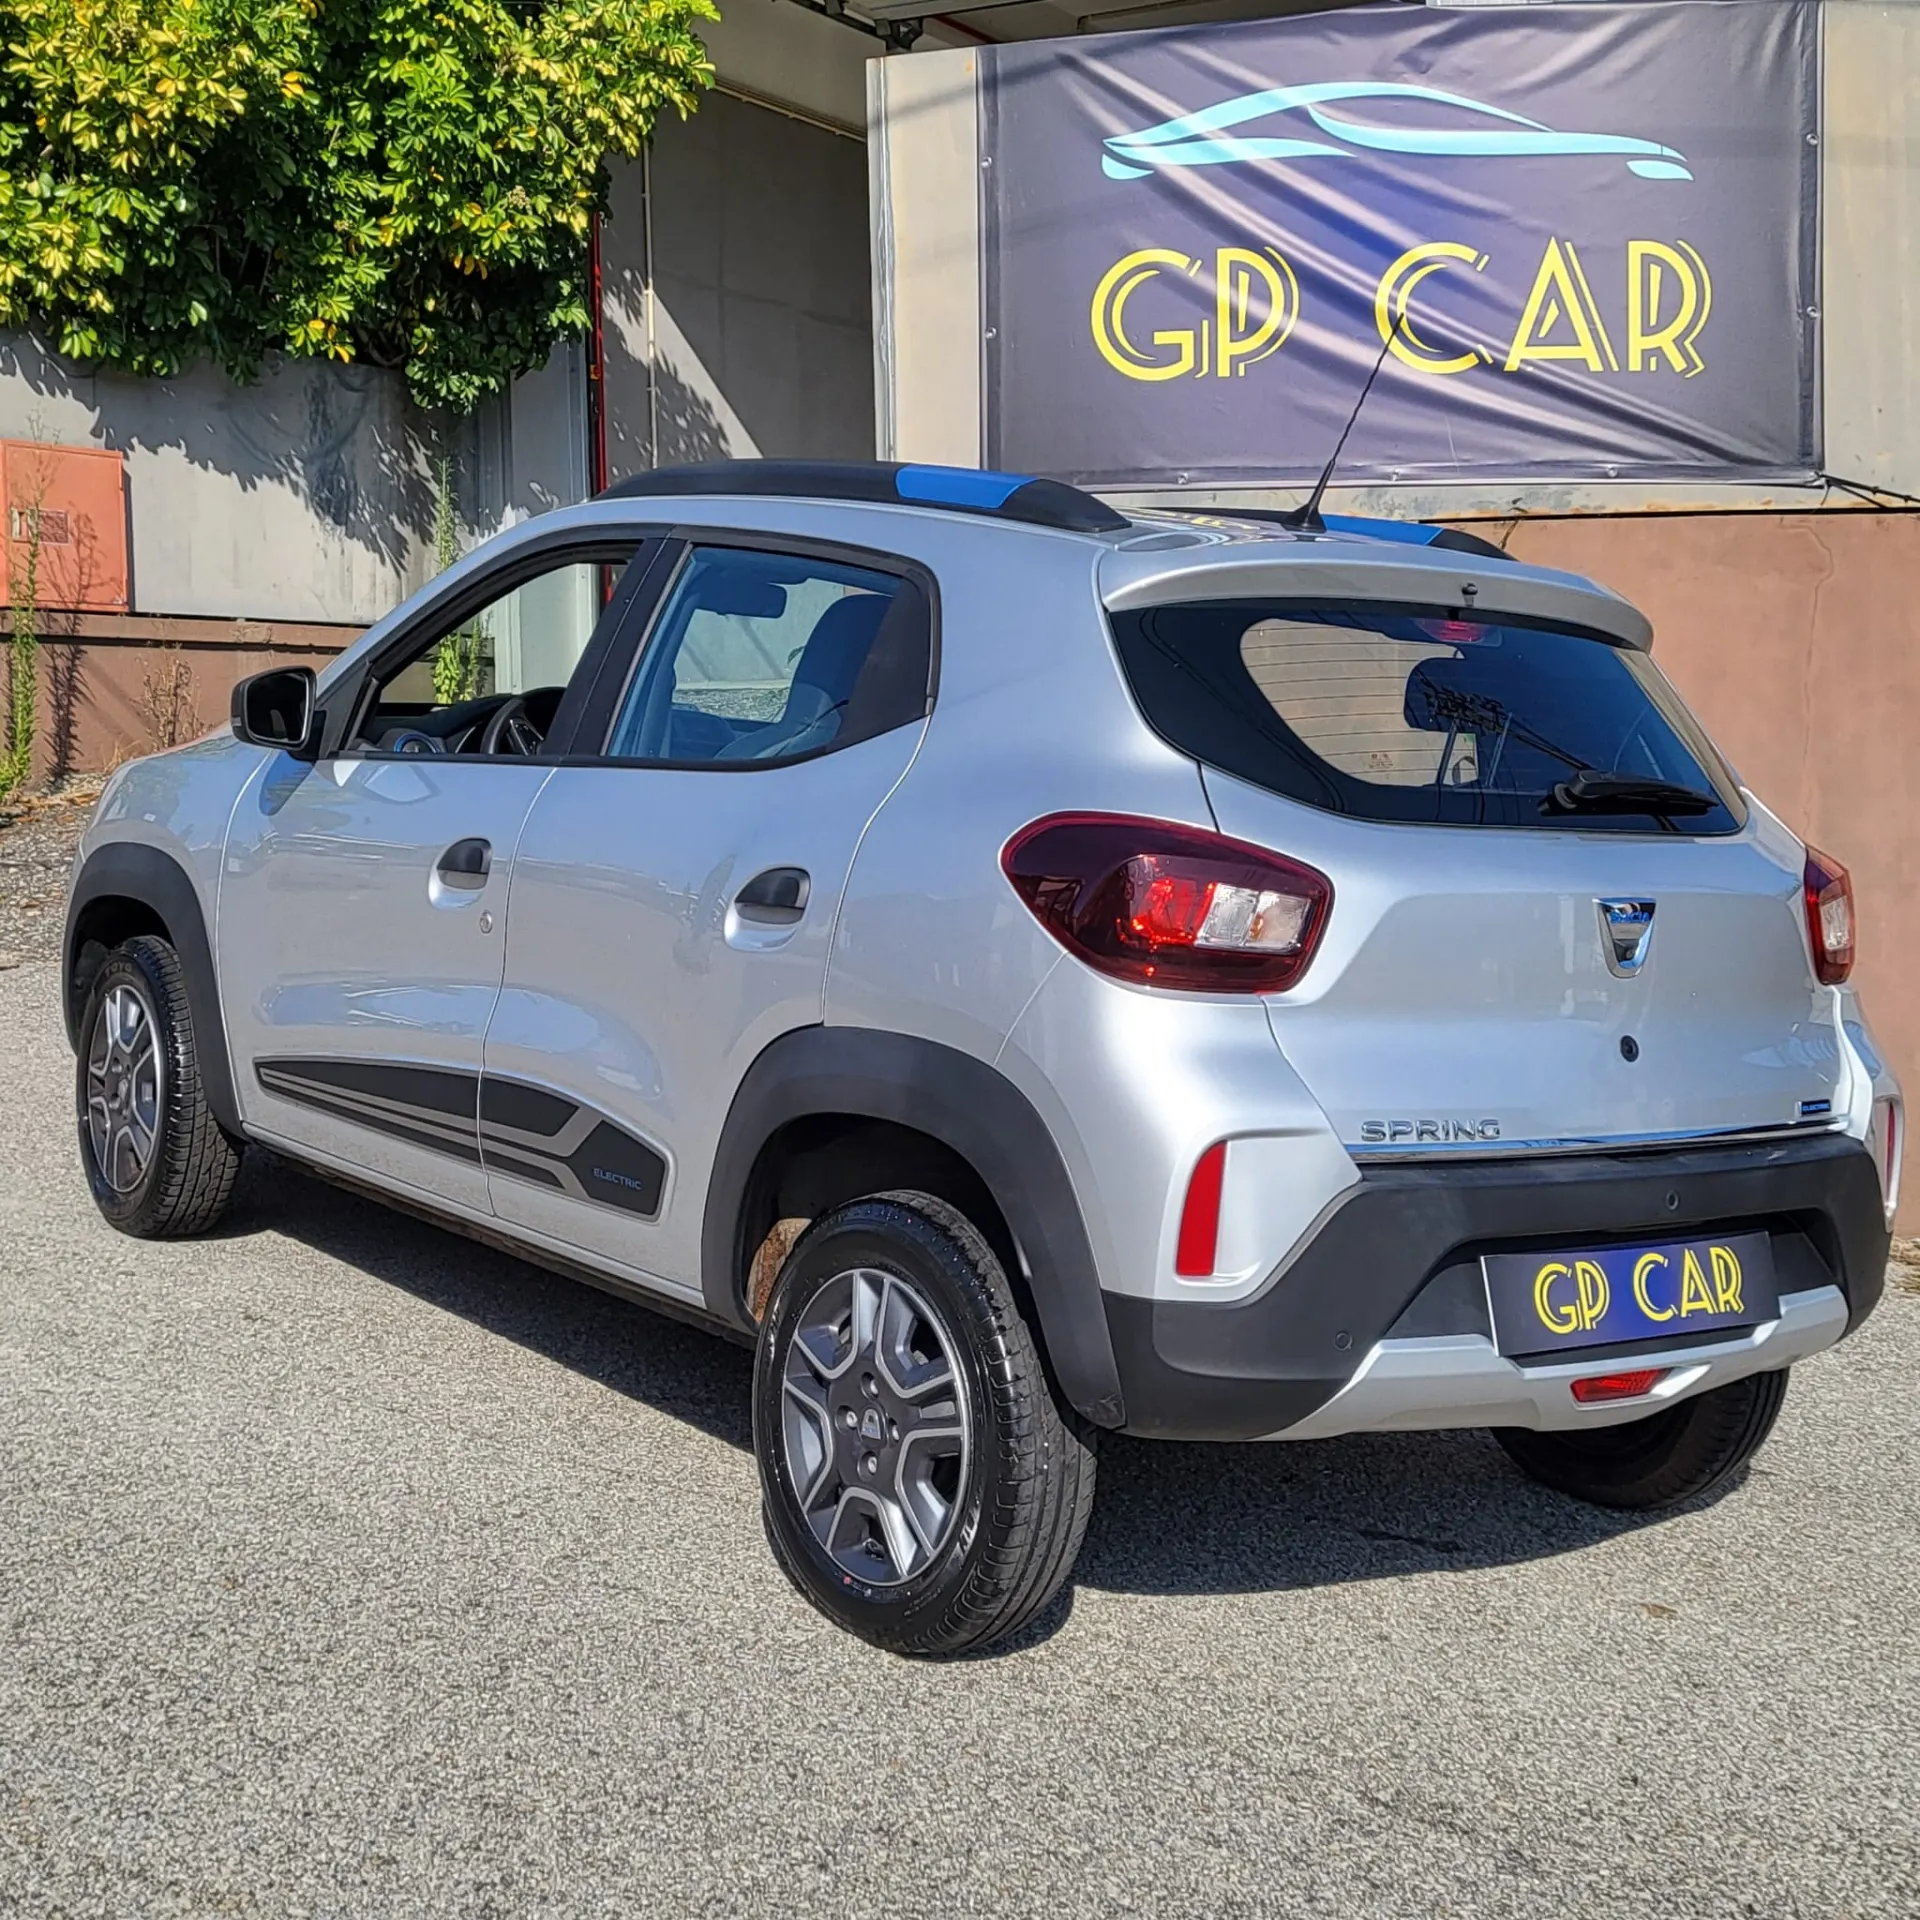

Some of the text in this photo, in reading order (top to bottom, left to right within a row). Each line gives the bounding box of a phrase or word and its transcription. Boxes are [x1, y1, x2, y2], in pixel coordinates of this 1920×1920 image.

[1090, 235, 1712, 381] GP CAR
[1361, 1119, 1500, 1142] SPRING
[593, 1167, 643, 1191] ELECTRIC
[1533, 1246, 1745, 1335] GP CAR
